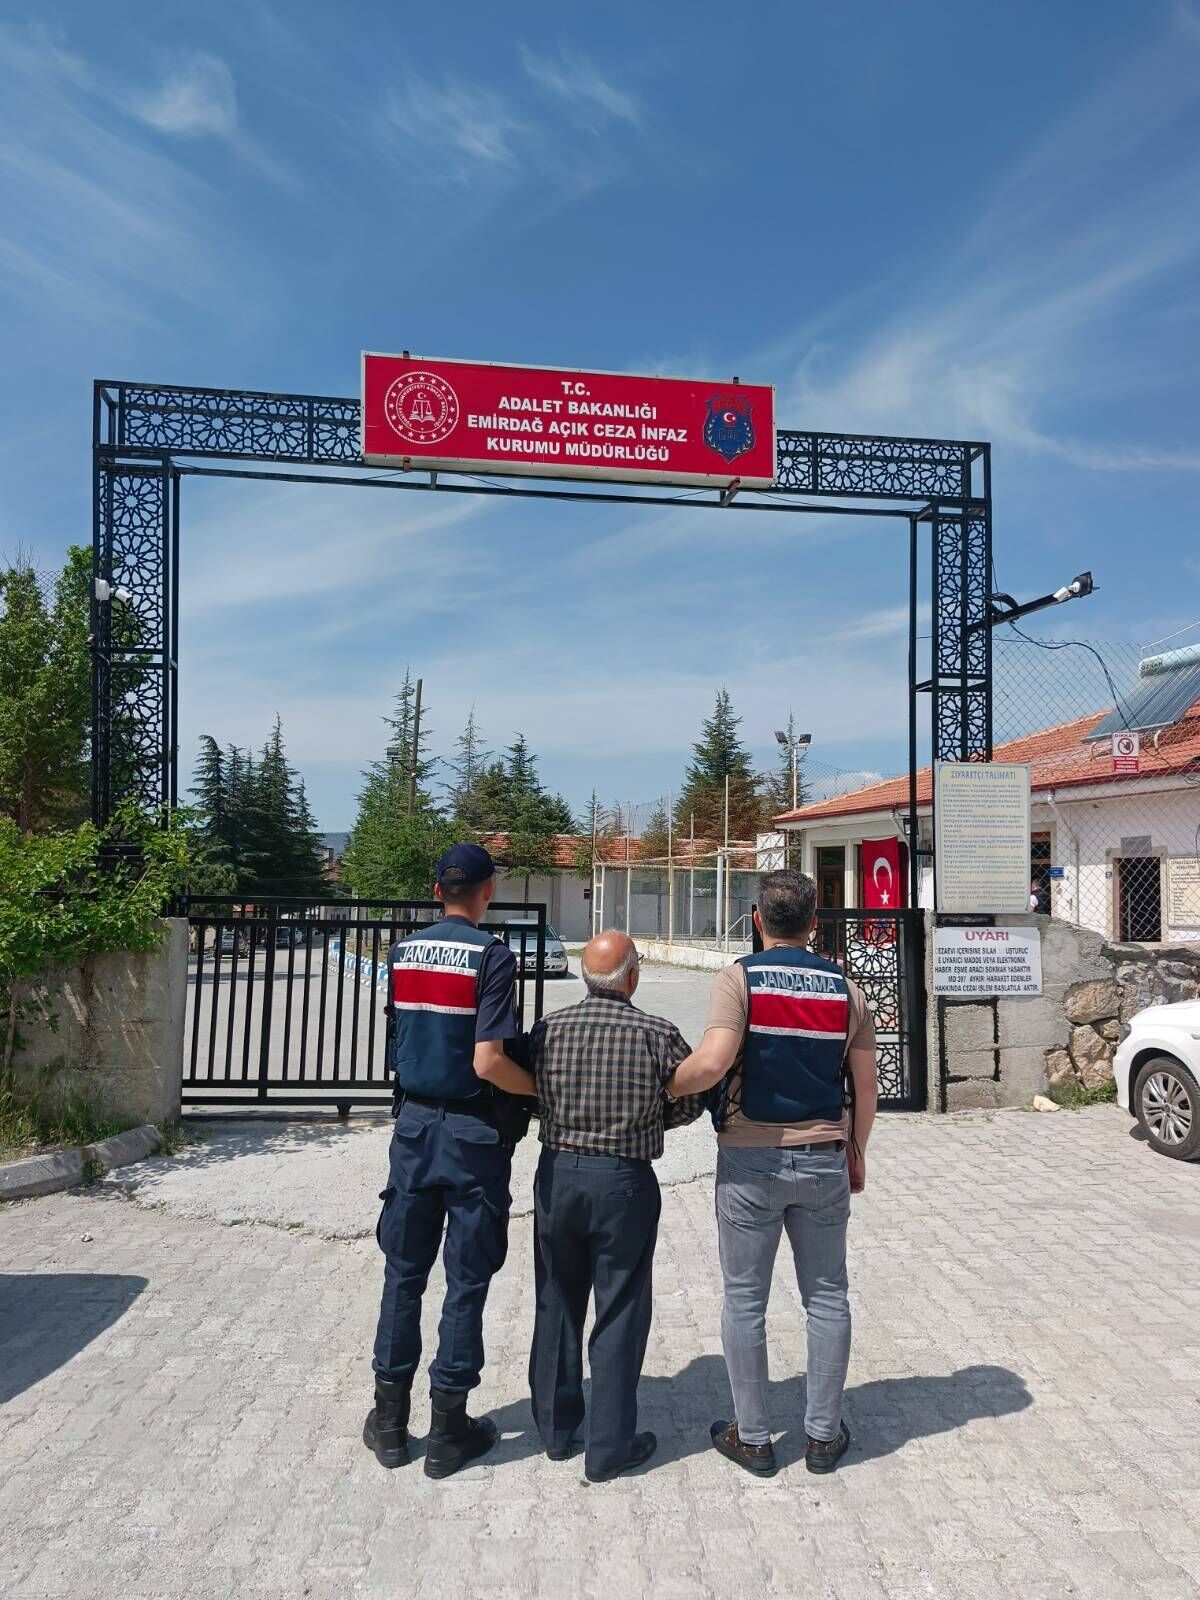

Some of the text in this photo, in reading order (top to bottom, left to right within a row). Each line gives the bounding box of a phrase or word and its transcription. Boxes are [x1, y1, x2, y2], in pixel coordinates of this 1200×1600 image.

[561, 381, 591, 396] T.C.
[498, 396, 657, 420] ADALET BAKANLIĞI
[467, 415, 688, 442] EMİRDAĞ AÇIK CEZA İNFAZ
[486, 436, 669, 462] KURUMU MÜDÜRLÜĞÜ
[965, 931, 1009, 941] UYARI
[400, 945, 469, 968] JANDARMA
[759, 971, 837, 992] JANDARMA
